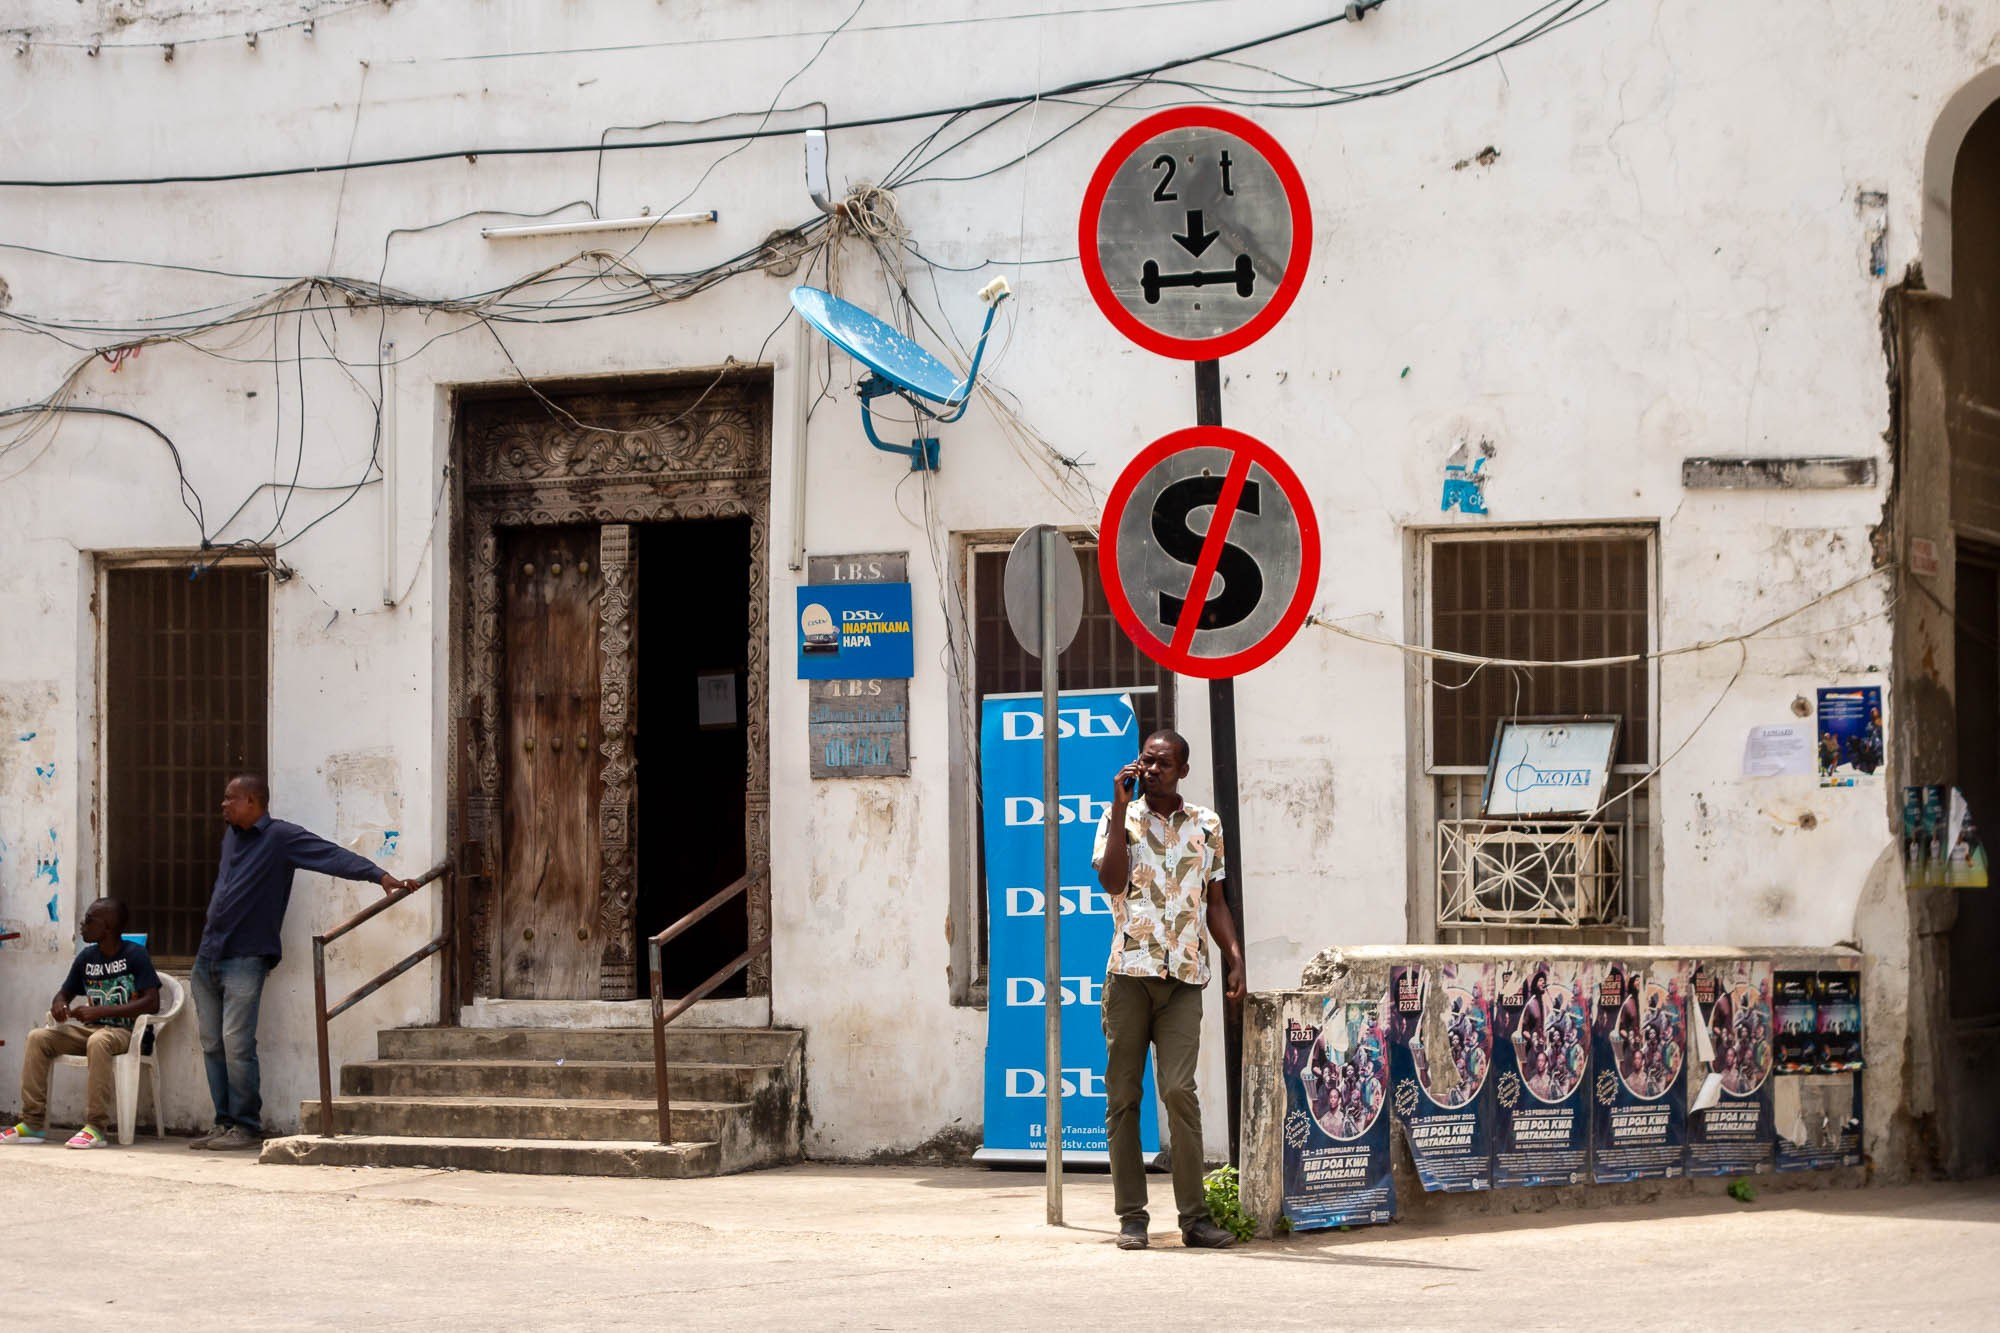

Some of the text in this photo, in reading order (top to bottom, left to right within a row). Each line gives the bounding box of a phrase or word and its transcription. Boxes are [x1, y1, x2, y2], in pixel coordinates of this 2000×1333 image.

[1152, 150, 1234, 202] 2 t
[1151, 475, 1264, 632] S
[843, 621, 910, 634] INAPATIKANA
[843, 636, 872, 647] HAPA
[1535, 771, 1583, 786] MOJA
[105, 958, 127, 975] VIBES
[1504, 996, 1523, 1005] 2021
[1292, 1031, 1312, 1040] 2021
[1045, 1126, 1105, 1134] vTanzania
[1430, 1126, 1450, 1137] POA
[1452, 1125, 1474, 1135] KWA
[1530, 1120, 1550, 1130] POA
[1551, 1119, 1572, 1129] KWA
[1303, 1157, 1368, 1171] BEI POA KWA
[1306, 1168, 1366, 1182] WATANZANIA
